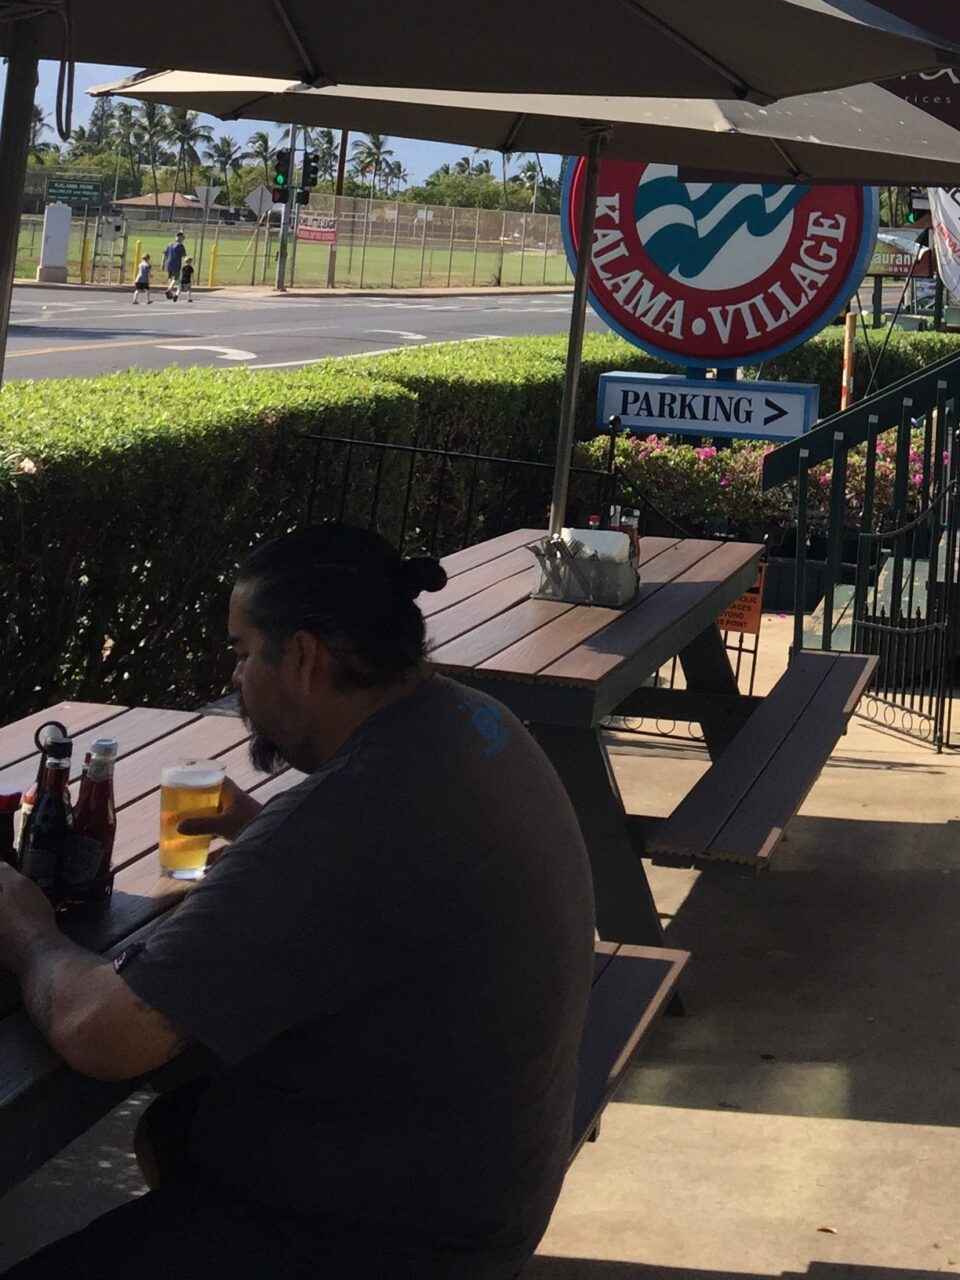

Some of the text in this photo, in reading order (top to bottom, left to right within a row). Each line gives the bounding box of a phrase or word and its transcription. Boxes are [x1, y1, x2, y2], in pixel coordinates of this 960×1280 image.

[591, 192, 847, 344] KALAMA VILLAGE
[620, 389, 755, 424] PARKING
